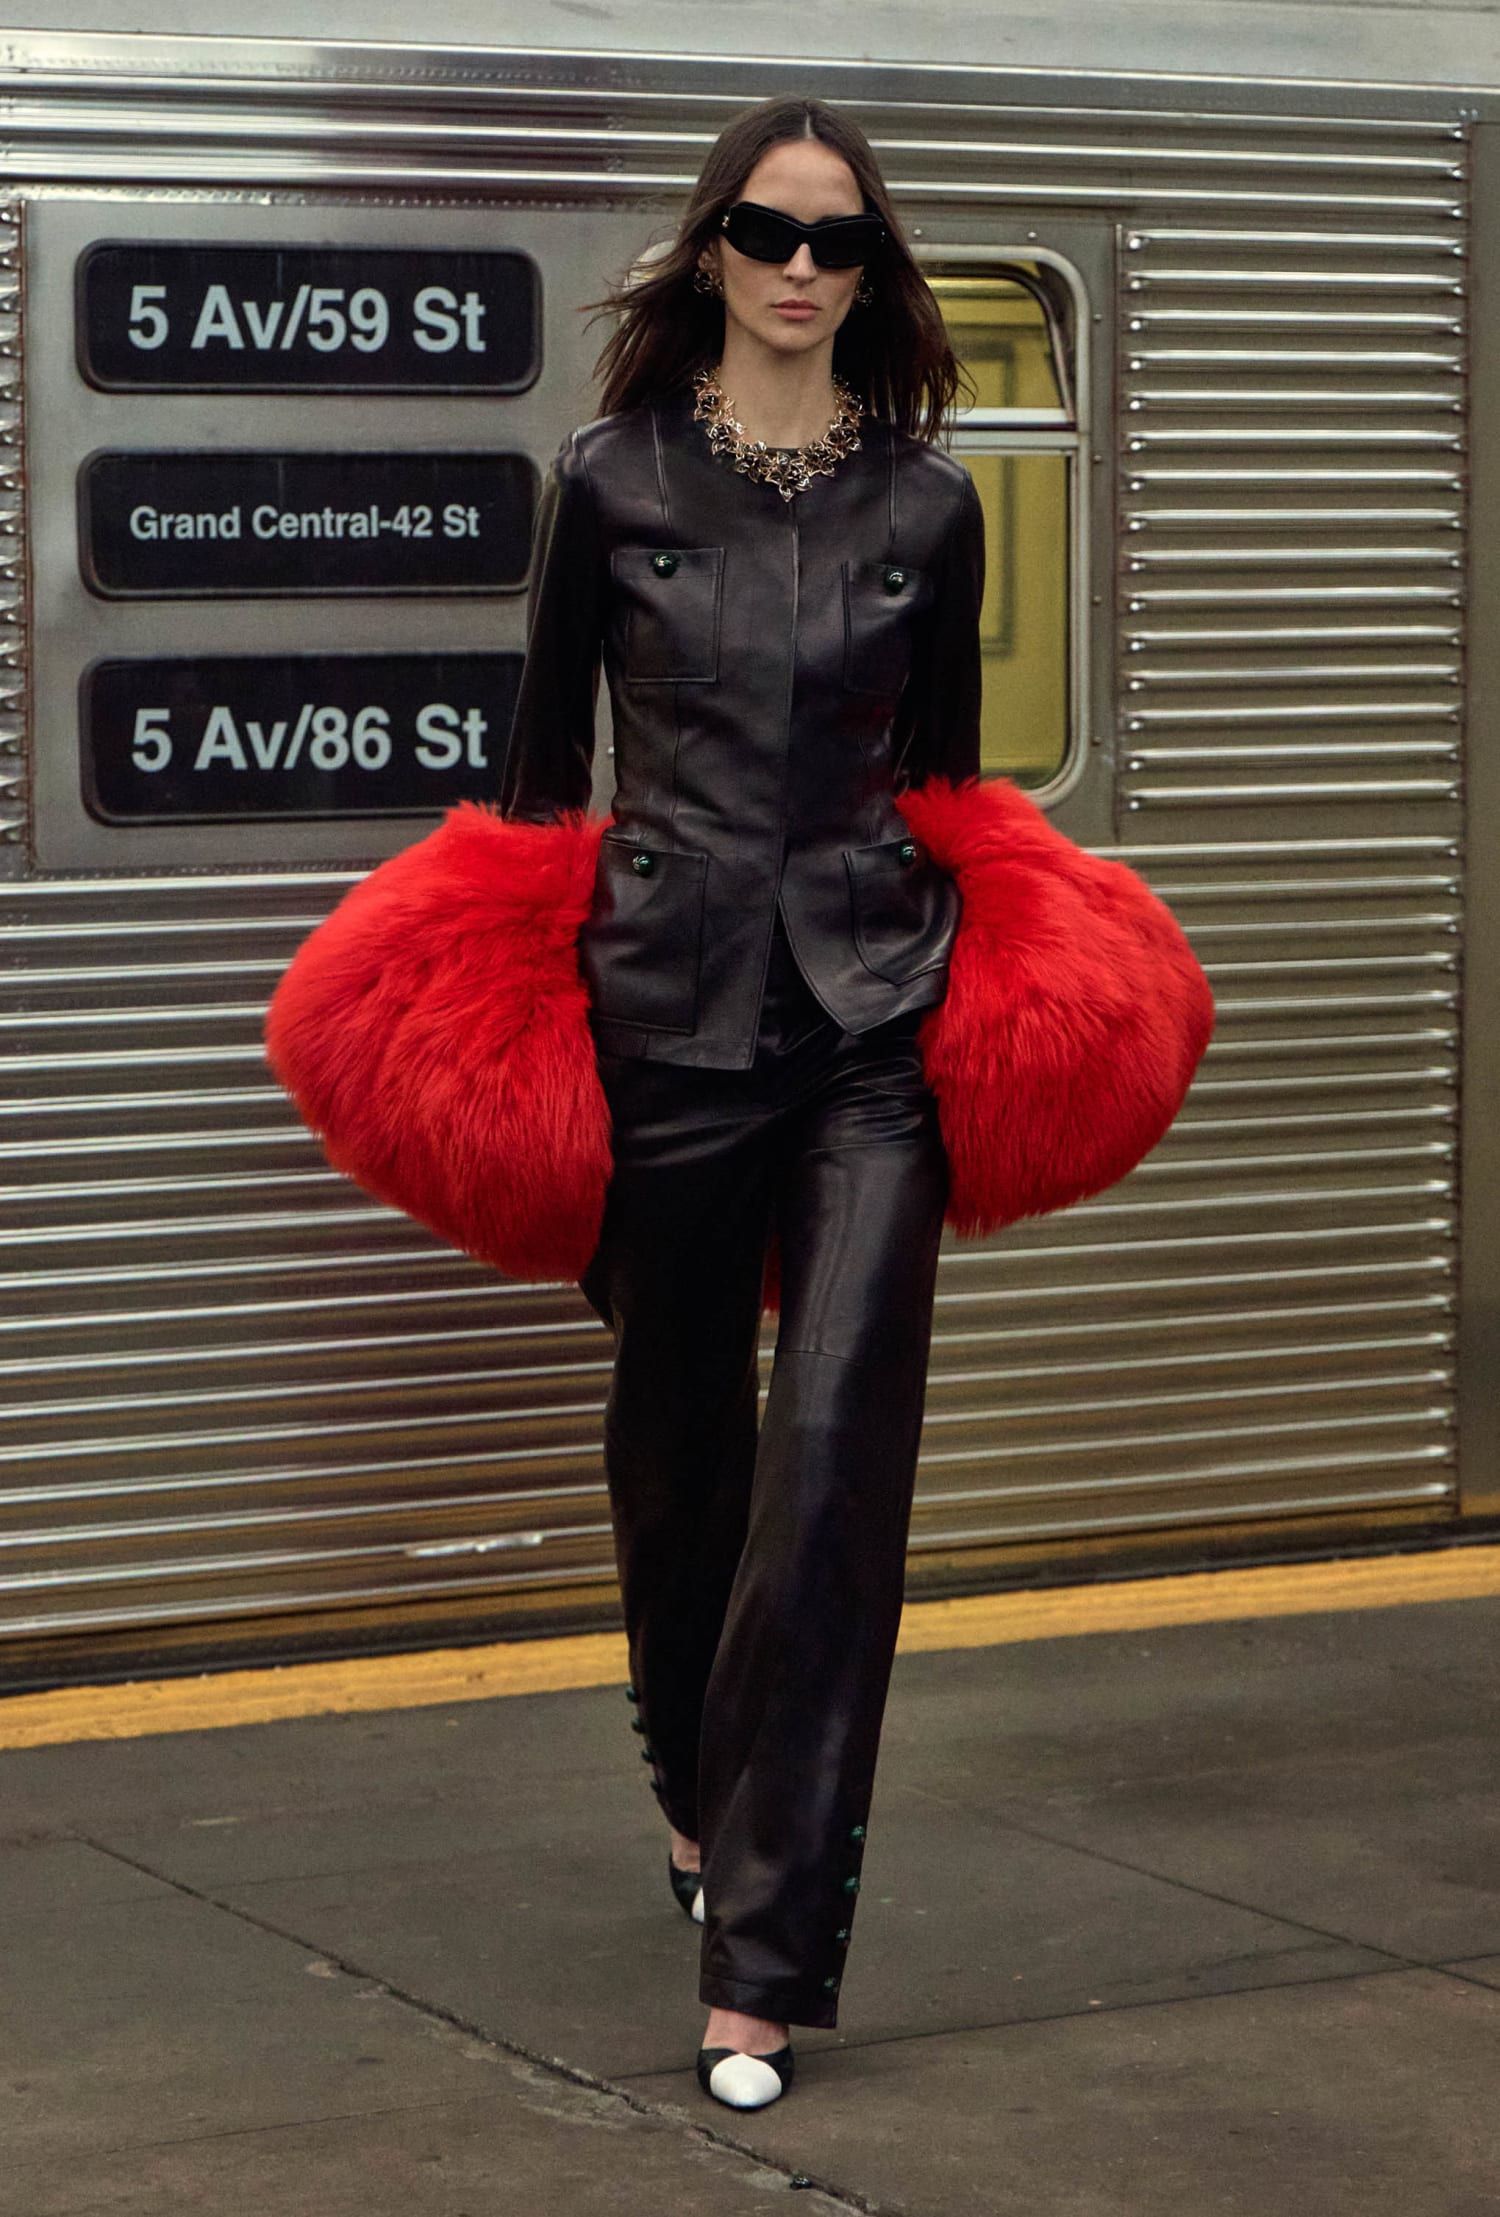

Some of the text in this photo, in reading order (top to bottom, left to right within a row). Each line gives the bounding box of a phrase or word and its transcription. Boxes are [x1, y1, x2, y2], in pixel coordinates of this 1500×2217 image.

[128, 284, 486, 353] 5 Av/59 St
[129, 504, 480, 540] Grand Central-42 St
[132, 703, 488, 772] 5 Av/86 St
